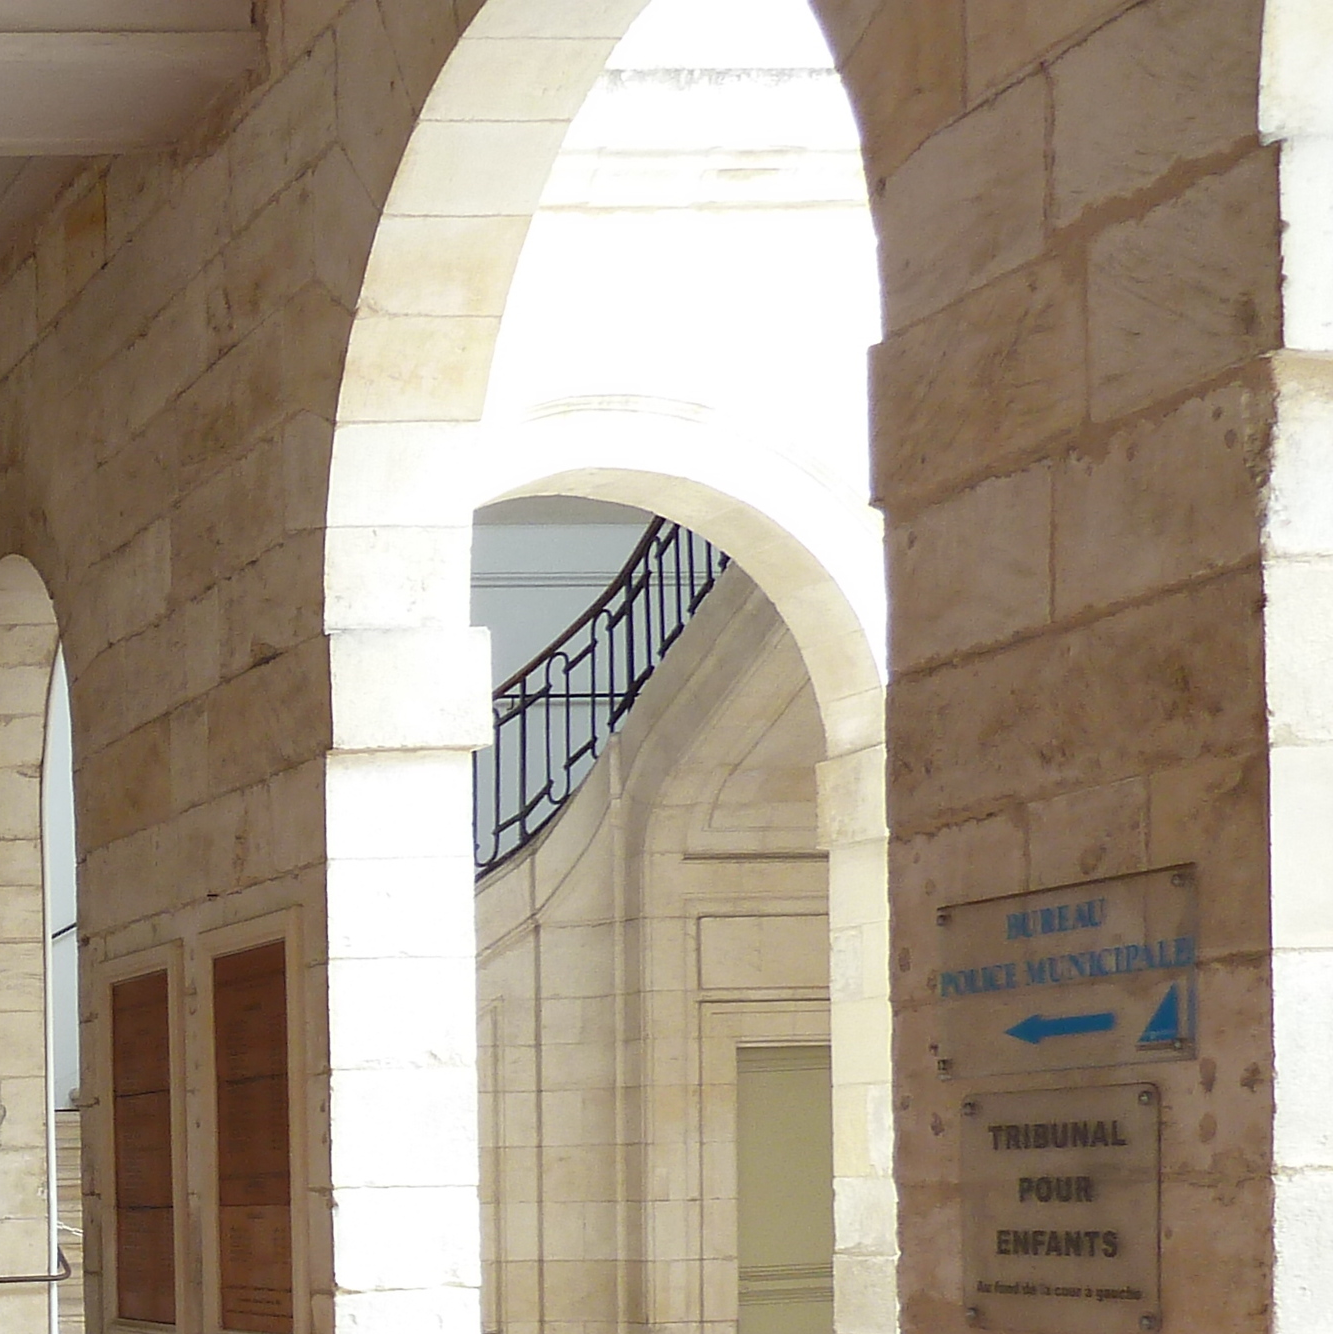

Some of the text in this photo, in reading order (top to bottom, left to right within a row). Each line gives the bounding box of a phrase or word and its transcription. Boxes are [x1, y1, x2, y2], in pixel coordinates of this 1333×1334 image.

[1006, 898, 1106, 940] BUREAU
[940, 935, 1196, 998] POLICE MUNICIPALE
[988, 1120, 1129, 1150] TRIBUNAL
[1019, 1176, 1094, 1203] POUR
[996, 1229, 1119, 1258] ENFANTS
